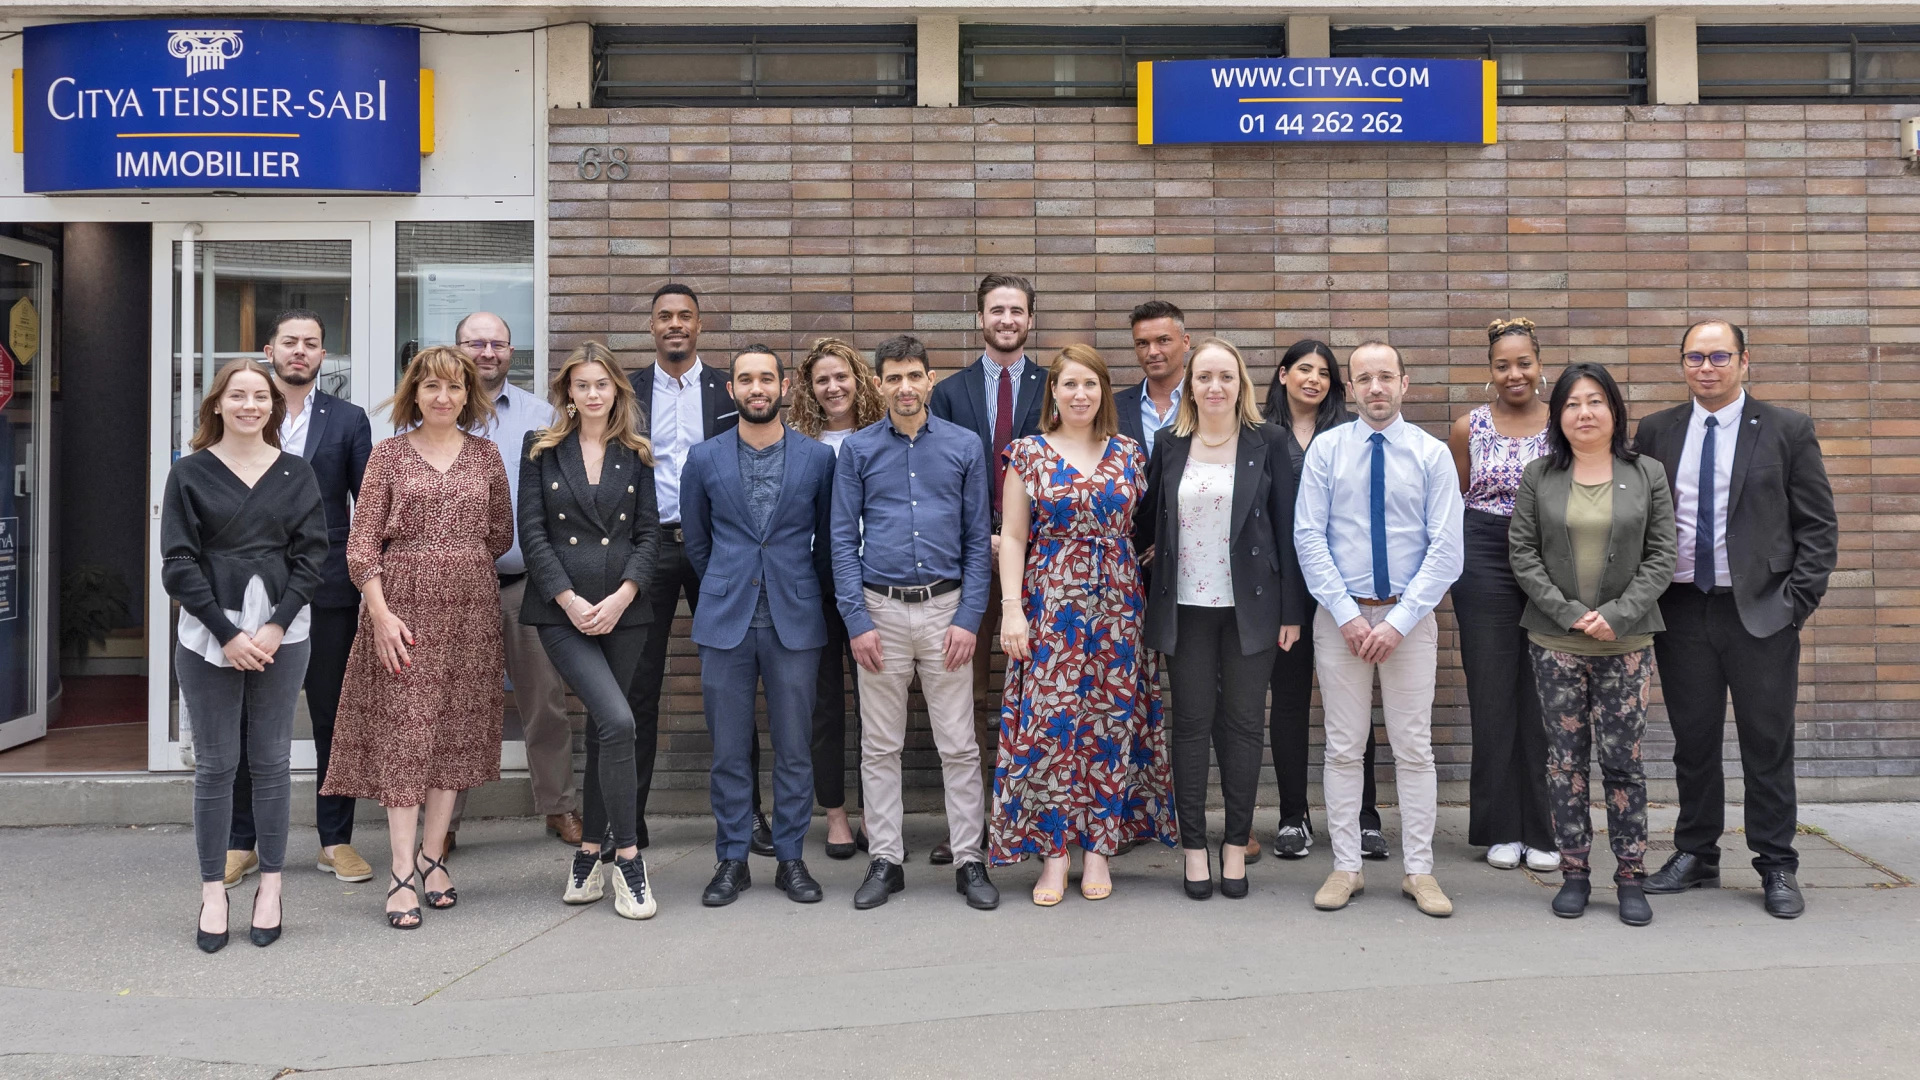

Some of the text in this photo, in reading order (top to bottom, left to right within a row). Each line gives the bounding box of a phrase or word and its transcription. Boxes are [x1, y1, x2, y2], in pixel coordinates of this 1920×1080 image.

[1211, 66, 1430, 88] WWW.CITYA.COM
[1239, 111, 1403, 135] 01 44 262 262
[116, 150, 300, 178] IMMOBILIER
[578, 146, 629, 180] 68
